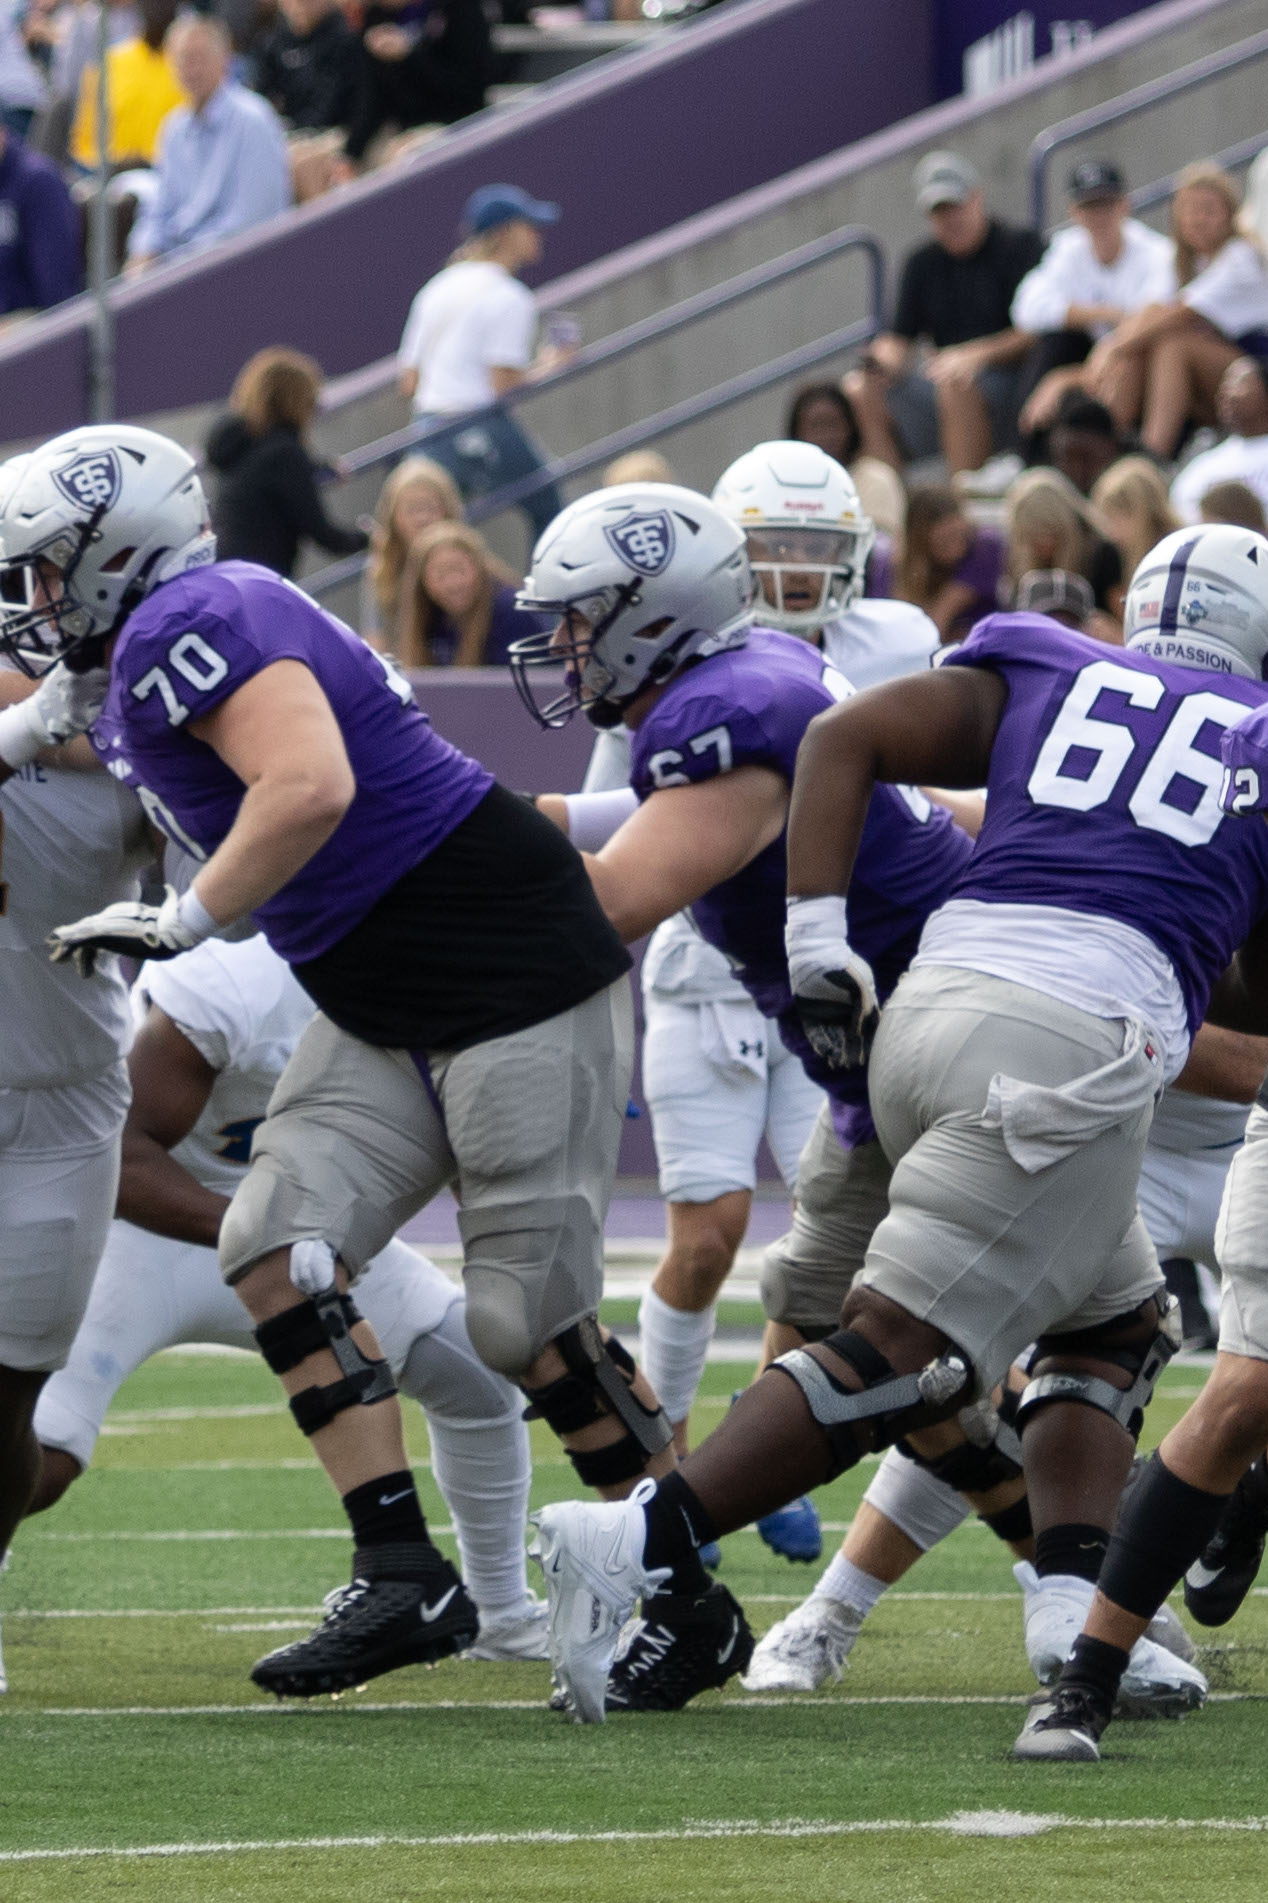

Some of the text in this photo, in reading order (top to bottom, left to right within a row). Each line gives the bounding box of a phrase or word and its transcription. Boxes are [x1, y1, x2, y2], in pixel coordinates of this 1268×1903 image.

[1186, 581, 1201, 592] 66
[131, 632, 229, 726] 70
[1153, 642, 1163, 656] &
[1166, 643, 1233, 674] PASSION
[648, 725, 733, 788] 67
[1027, 660, 1257, 848] 66
[1218, 767, 1260, 814] 12
